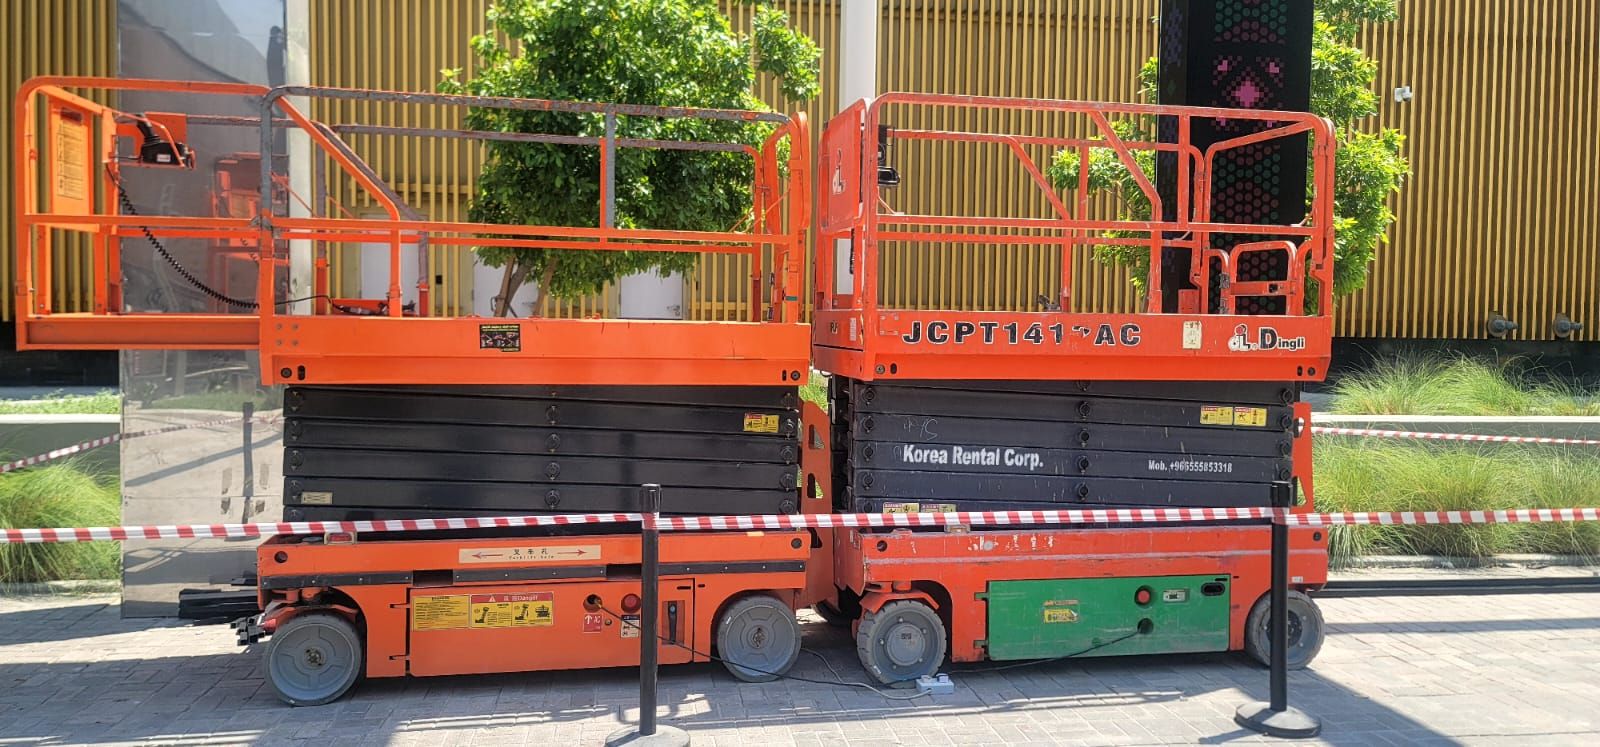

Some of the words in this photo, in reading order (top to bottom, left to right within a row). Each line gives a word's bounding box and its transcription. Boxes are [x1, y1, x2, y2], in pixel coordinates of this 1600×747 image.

[1259, 326, 1305, 351] Dingli
[903, 444, 948, 464] Korea
[952, 446, 1000, 466] Rental
[1004, 449, 1044, 471] Corp.
[1148, 460, 1168, 471] Mob.
[1169, 461, 1233, 473] +966555853318
